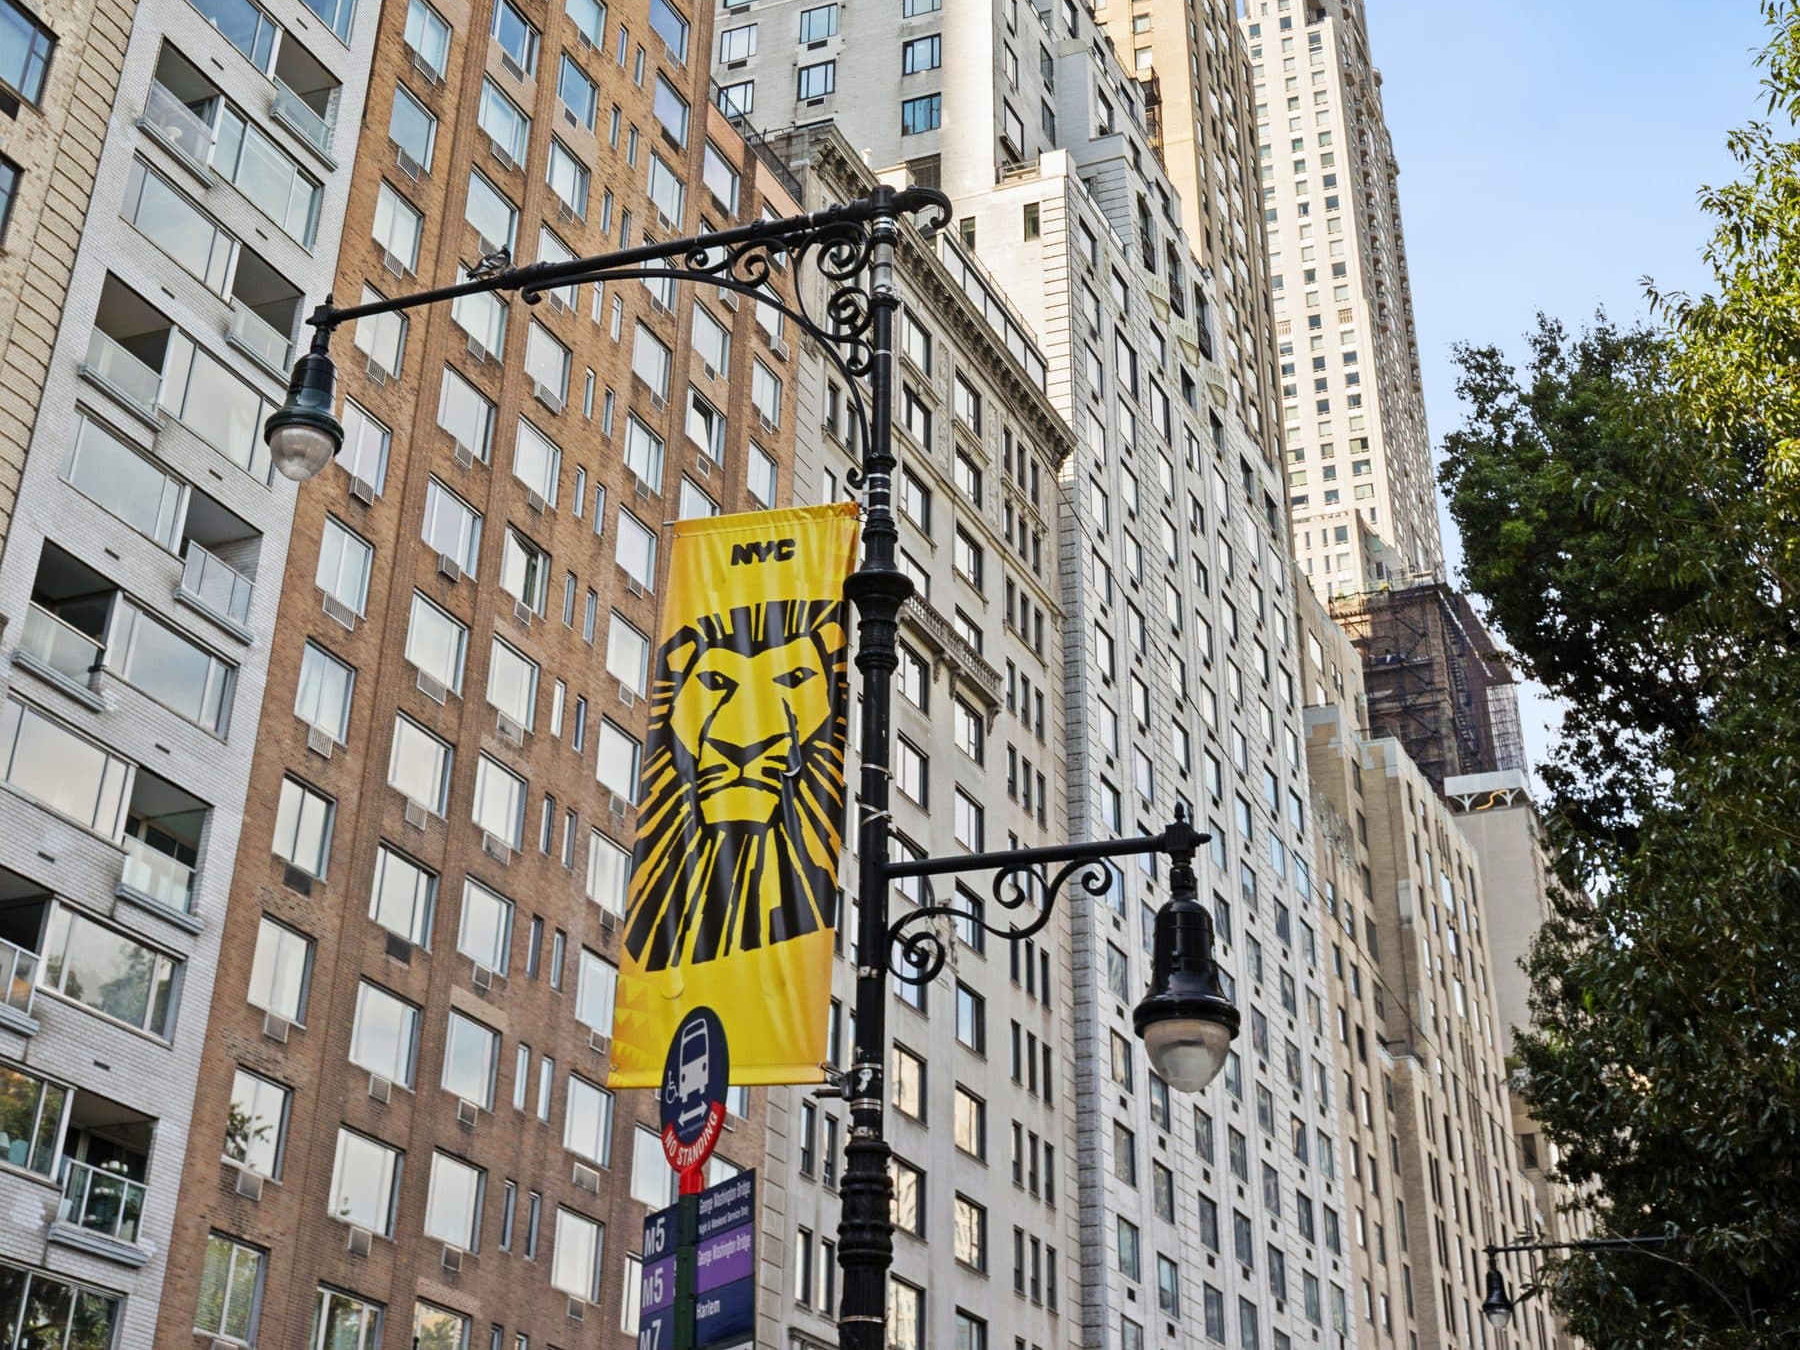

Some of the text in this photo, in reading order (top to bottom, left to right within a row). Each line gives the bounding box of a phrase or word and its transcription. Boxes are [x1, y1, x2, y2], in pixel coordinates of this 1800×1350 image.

[730, 538, 796, 566] NYC
[665, 1111, 718, 1166] NO STANDING
[699, 1180, 751, 1215] George Washington Bridge
[644, 1216, 666, 1257] M5
[697, 1234, 751, 1267] George Washington Bridge
[642, 1266, 663, 1308] M5
[696, 1299, 720, 1319] Harlem
[639, 1318, 661, 1350] M7
